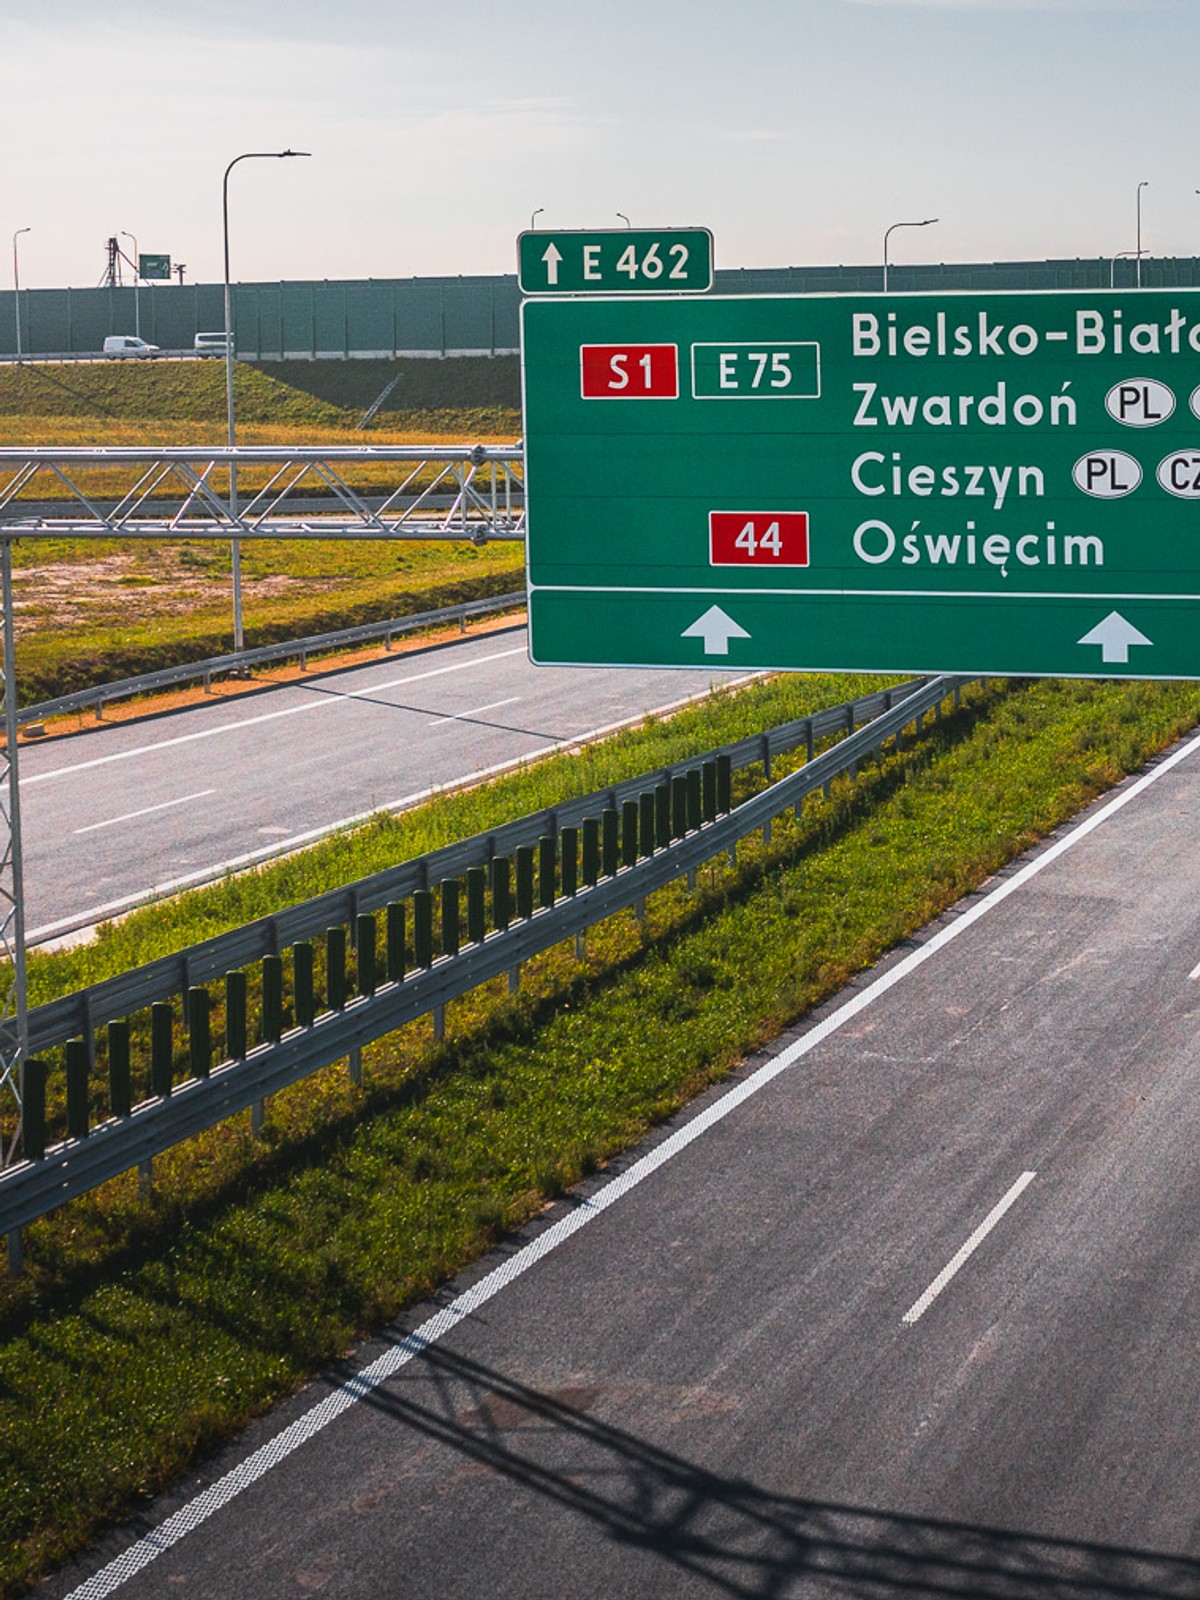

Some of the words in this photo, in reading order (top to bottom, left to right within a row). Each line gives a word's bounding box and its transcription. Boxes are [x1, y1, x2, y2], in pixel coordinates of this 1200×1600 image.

[852, 381, 1077, 426] Zwardoń
[1119, 386, 1162, 419] PL
[851, 451, 1044, 509] Cieszyn
[1086, 457, 1128, 491] PL
[735, 521, 783, 557] 44
[853, 519, 1104, 578] Oświęcim
